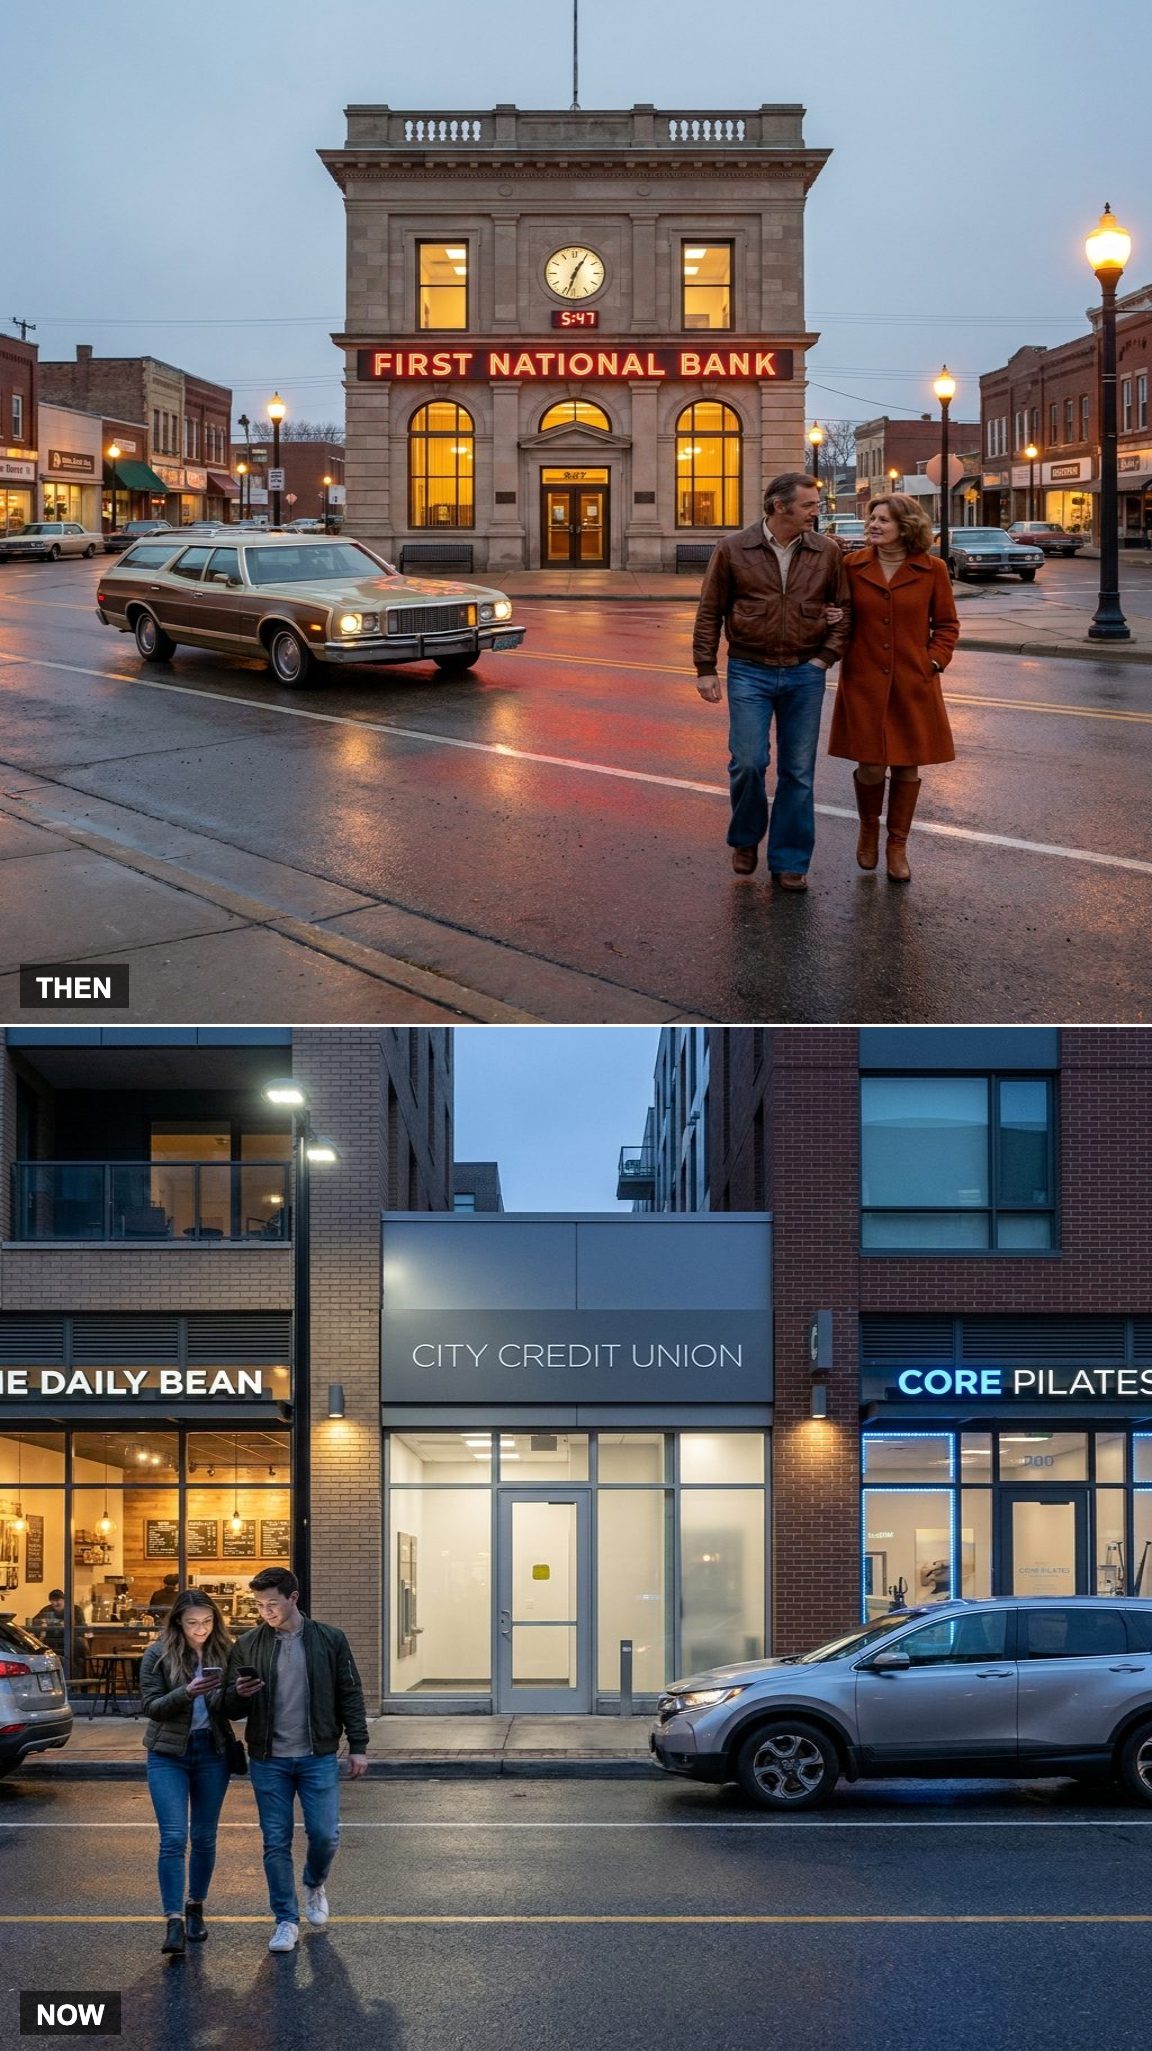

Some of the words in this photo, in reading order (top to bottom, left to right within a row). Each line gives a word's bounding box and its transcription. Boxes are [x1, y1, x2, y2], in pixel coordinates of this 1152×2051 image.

[561, 311, 595, 326] 5:47
[374, 353, 472, 376] FIRST
[489, 353, 665, 376] NATIONAL
[681, 353, 776, 376] BANK
[412, 1343, 488, 1368] CITY
[498, 1343, 621, 1368] CREDIT
[632, 1343, 743, 1368] UNION
[0, 1370, 28, 1395] E
[41, 1370, 148, 1395] DAILY
[160, 1370, 262, 1395] BEAN
[898, 1369, 1002, 1395] CORE
[1014, 1369, 1152, 1395] PILATES
